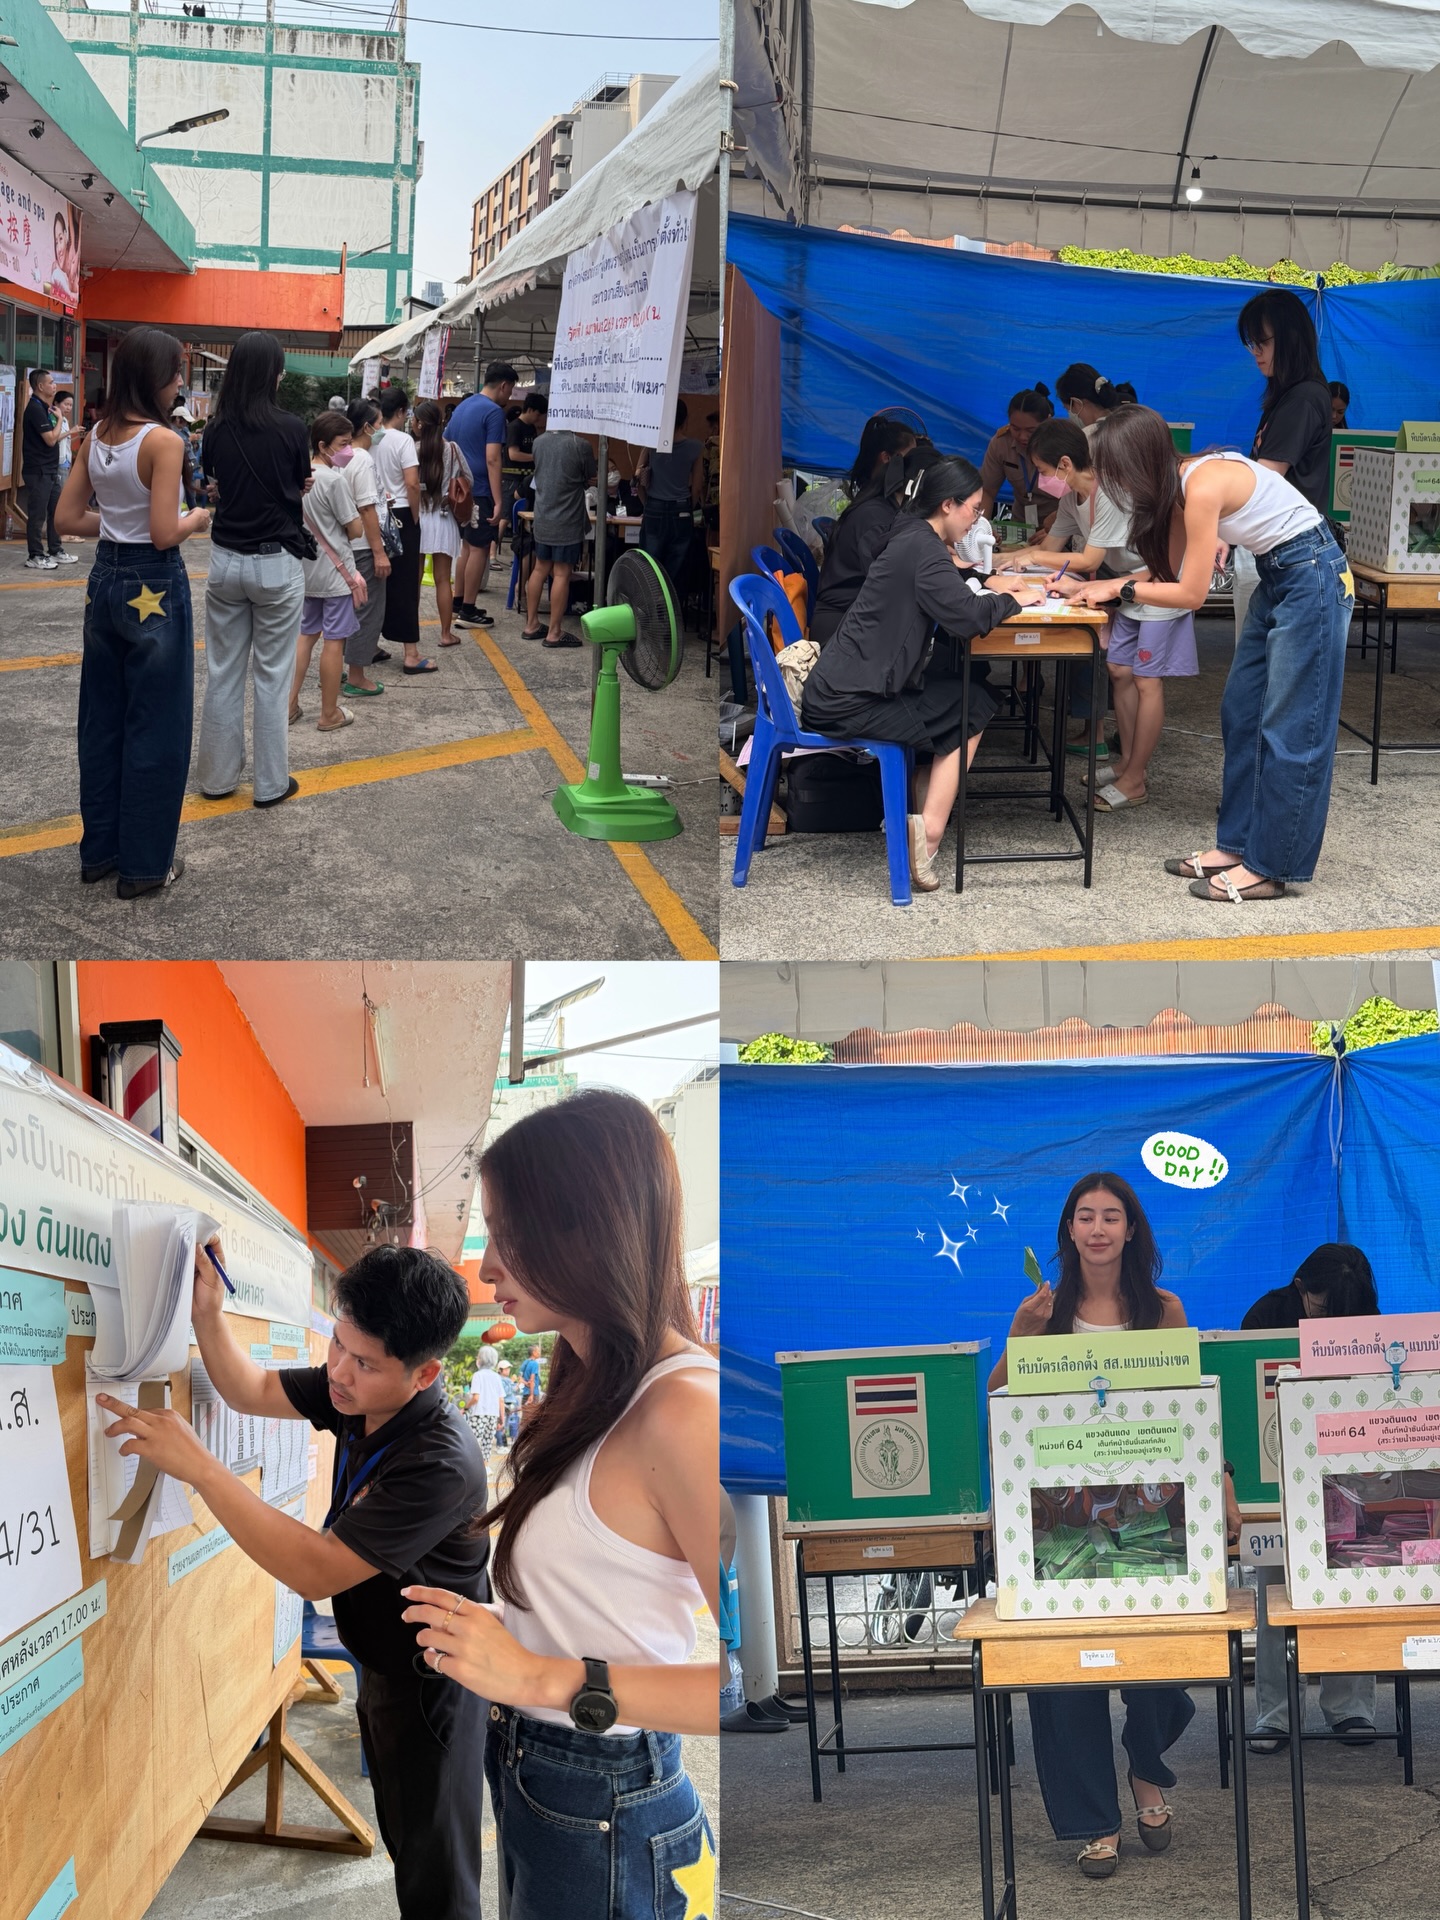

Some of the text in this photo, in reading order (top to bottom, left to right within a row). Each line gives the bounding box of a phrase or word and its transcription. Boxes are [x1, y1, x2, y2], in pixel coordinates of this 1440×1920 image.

[18, 193, 31, 212] and
[33, 202, 45, 222] spa
[0, 1113, 147, 1202] รเป็นการทั่วไป
[37, 1206, 111, 1268] ดินแดง
[0, 1291, 22, 1312] าศ
[1311, 1332, 1386, 1357] หีบบัตรเลือกตั้ง
[1017, 1349, 1190, 1375] หีบบัตรเลือกตั้ง สส.แบบแบ่งเขต
[1086, 1425, 1177, 1439] แขวงดินแดง เขตดินแดง
[1319, 1426, 1366, 1438] หน่วยที่ 64
[1369, 1415, 1417, 1425] แขวงดินแดง
[1039, 1439, 1083, 1451] หน่วยที่ 64
[0, 1626, 59, 1681] ศหลังเวลา
[61, 1603, 88, 1636] 17.00
[1, 1676, 40, 1716] ประกาศ
